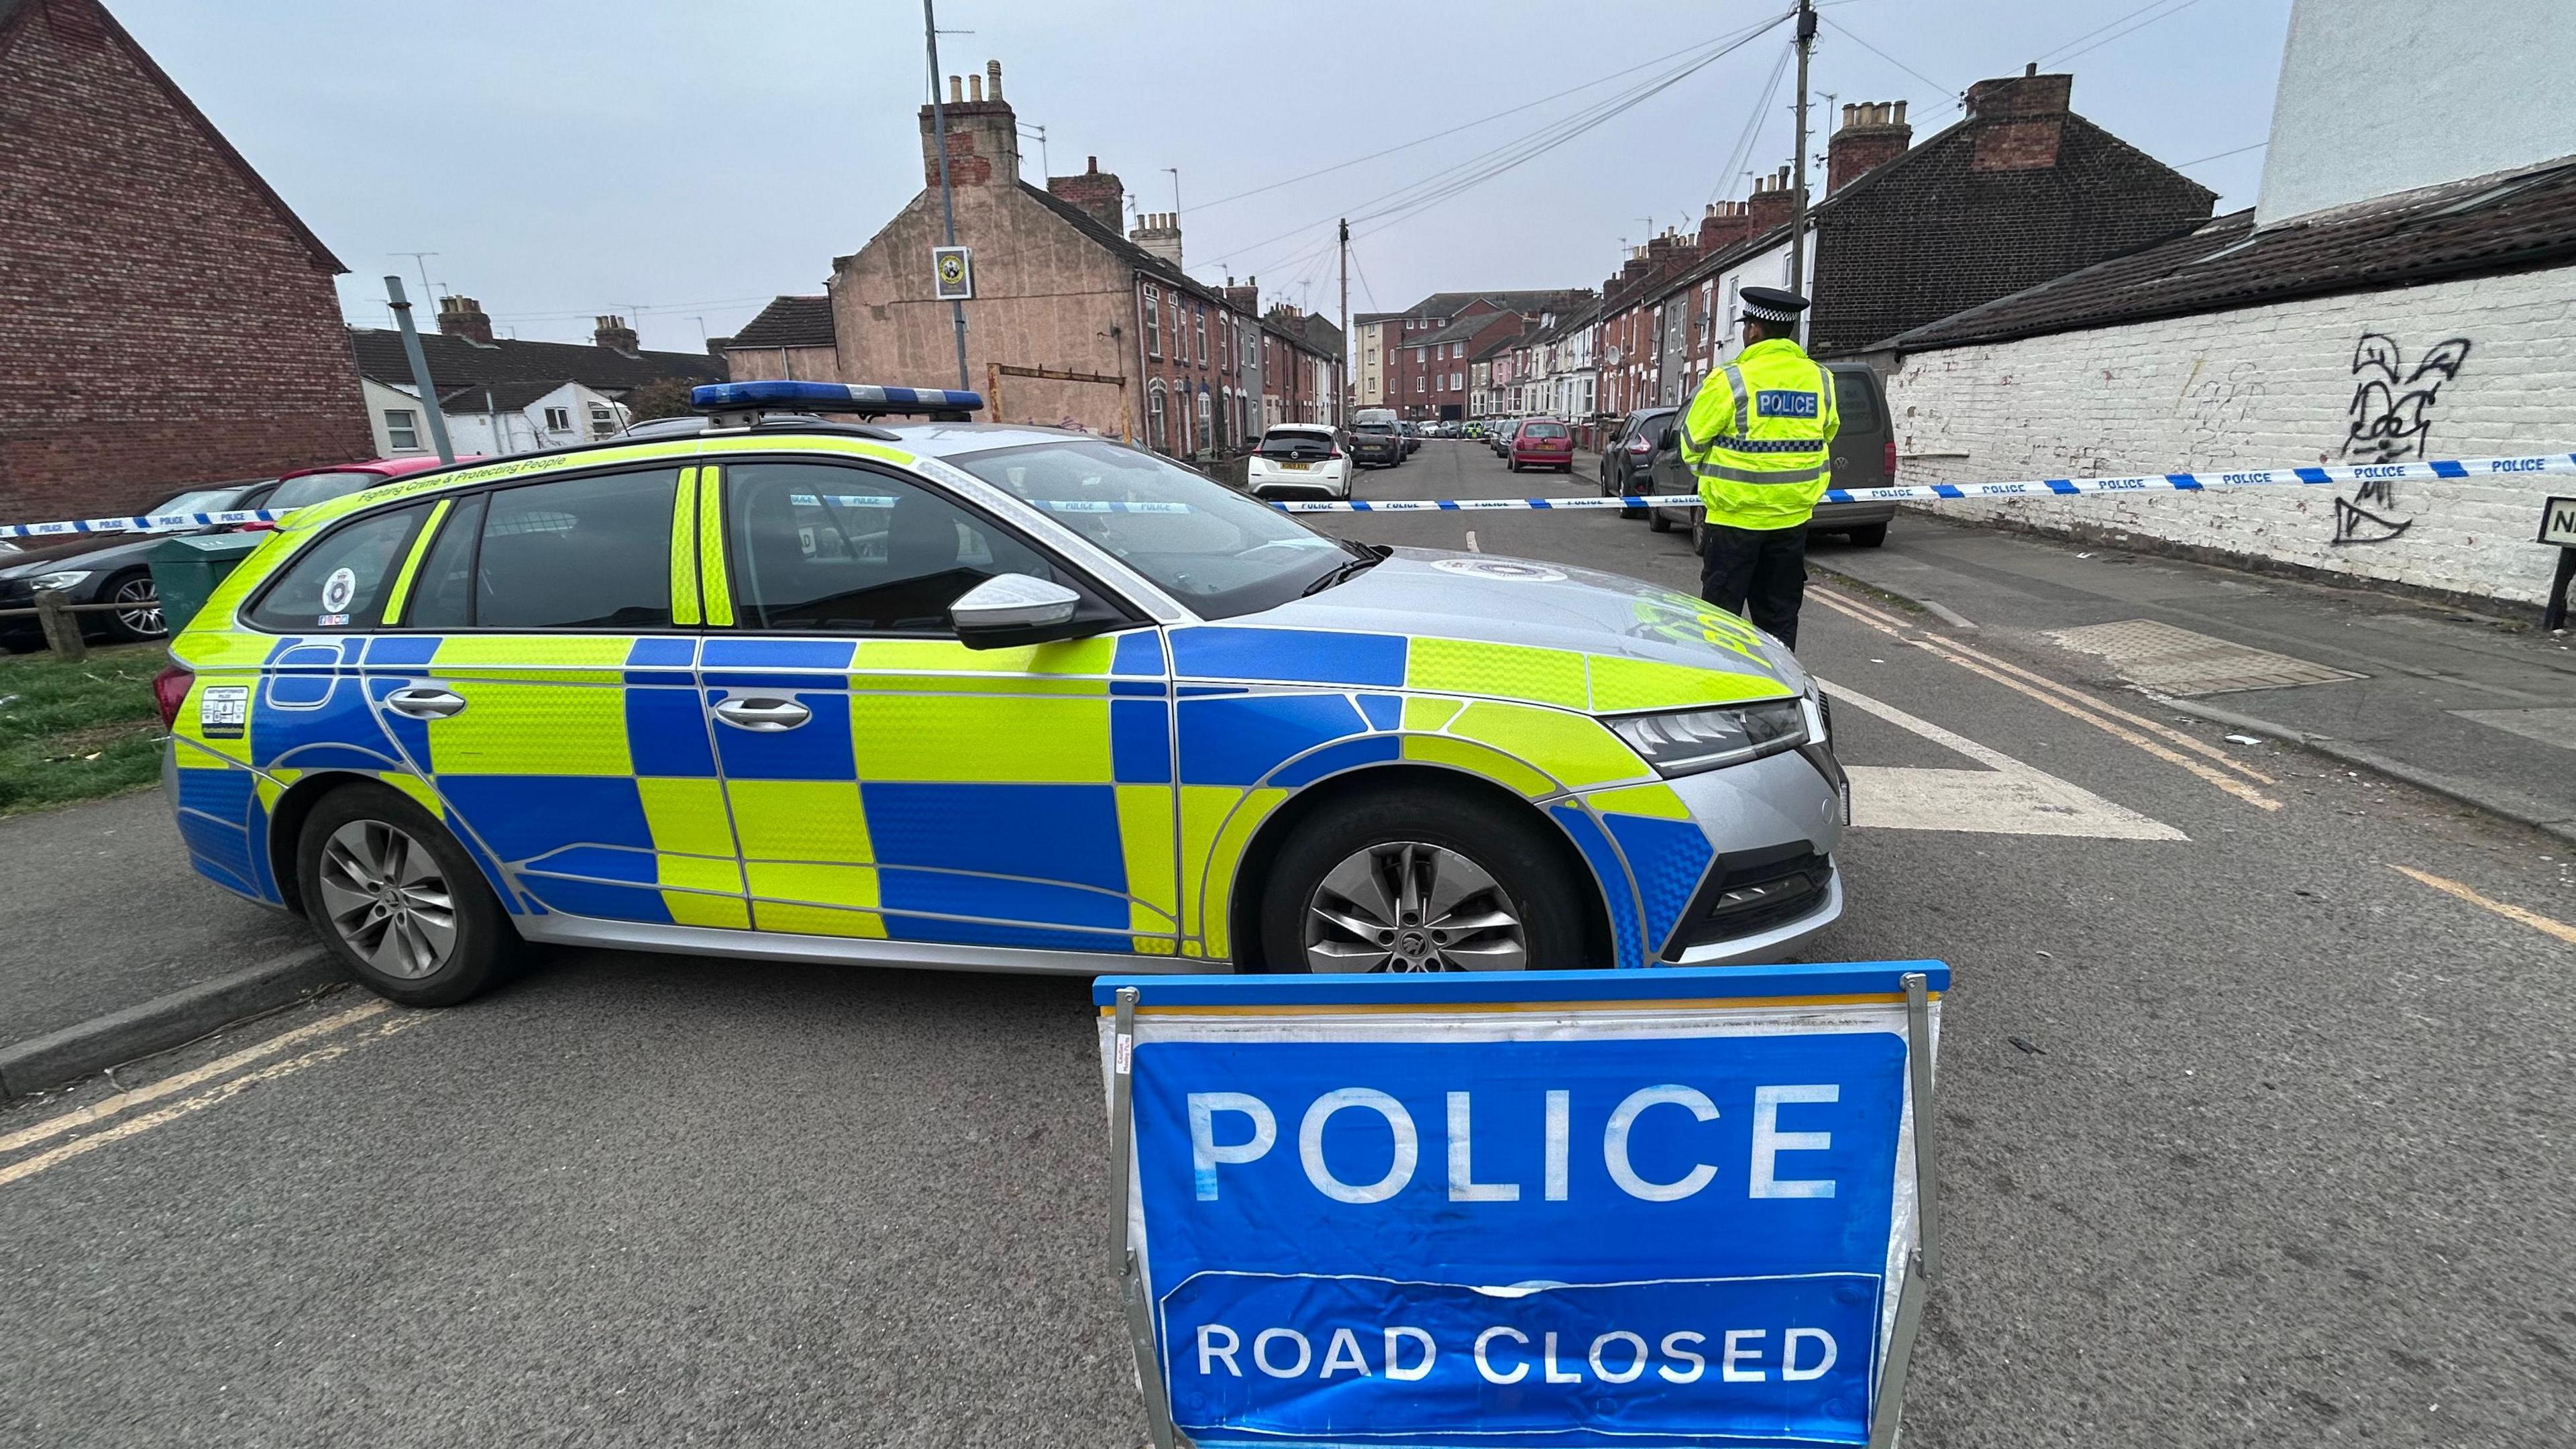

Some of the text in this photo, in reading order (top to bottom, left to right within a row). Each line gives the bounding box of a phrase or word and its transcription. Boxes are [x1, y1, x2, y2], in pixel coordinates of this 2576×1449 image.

[1760, 394, 1815, 413] POLICE
[358, 457, 566, 502] Fighting Crime & Protecting People
[1872, 489, 1913, 497] POLICE
[1982, 484, 2026, 494] POLICE
[2098, 479, 2145, 489] POLICE
[2222, 473, 2273, 484] POLICE
[2354, 466, 2406, 478] POLICE
[2491, 458, 2545, 472] POLICE
[1066, 502, 1171, 511] POLICE POLICE
[2553, 510, 2576, 533] N
[40, 513, 245, 532] POLICE POLICE POLICE POLICE
[1187, 1083, 1840, 1204] POLICE
[1197, 1323, 1838, 1384] ROAD CLOSED
